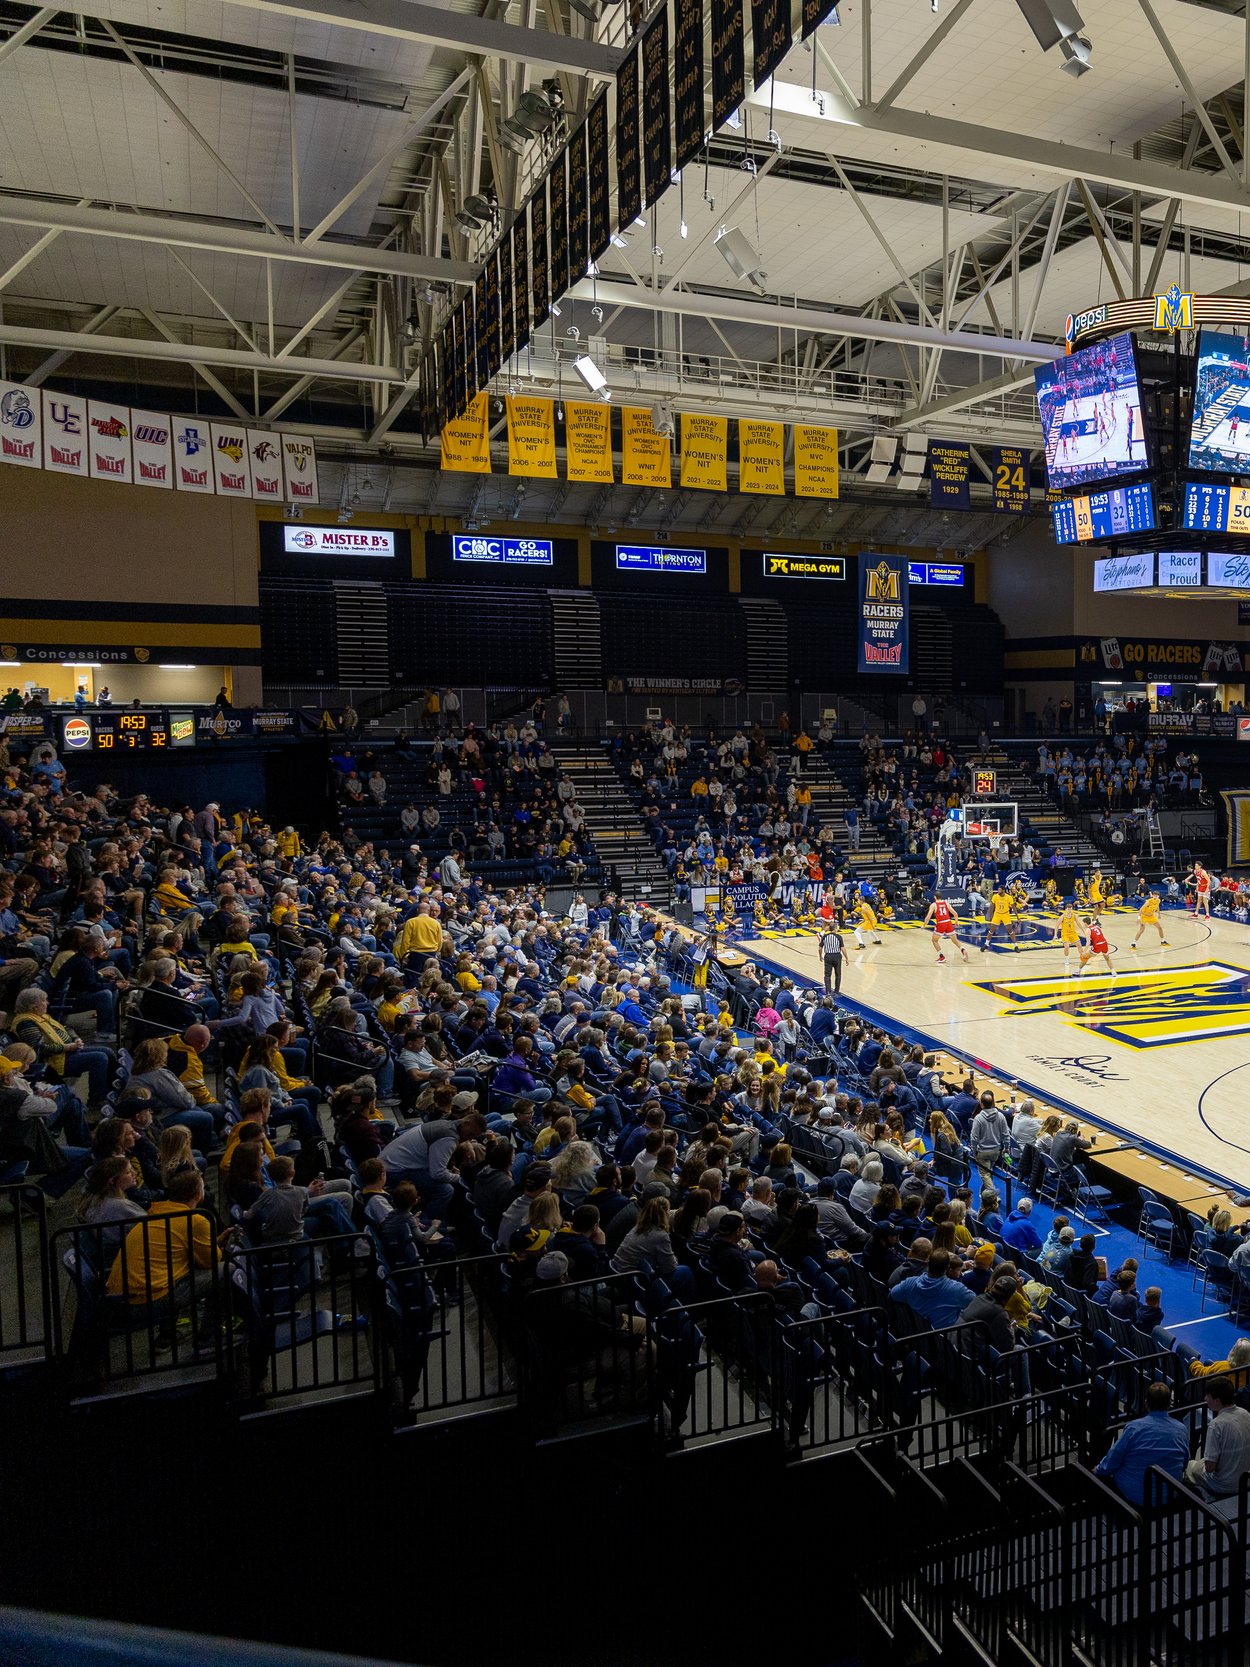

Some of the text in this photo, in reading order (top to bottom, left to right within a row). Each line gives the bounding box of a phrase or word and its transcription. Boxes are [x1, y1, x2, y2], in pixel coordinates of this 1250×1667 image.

[1075, 305, 1106, 334] pepsi
[690, 418, 718, 427] MURRAY
[134, 425, 169, 446] UIC
[684, 433, 724, 444] UNIVERSITY
[803, 430, 830, 438] MURRAY
[218, 436, 244, 448] UNI
[286, 444, 312, 456] VALPO
[798, 444, 834, 452] UNIVERSITY
[931, 448, 969, 458] CATHERINE
[684, 450, 724, 462] WOMEN'S
[1000, 450, 1022, 458] SHEILA
[698, 460, 710, 468] NIT
[798, 464, 835, 474] CHAMPIONS
[932, 464, 968, 474] WICKLIFFE
[687, 476, 721, 486] 2021 2022
[936, 473, 966, 481] PERDEW
[996, 465, 1026, 491] 24
[290, 480, 312, 496] VALLEY
[1090, 494, 1108, 506] 19:53
[1114, 506, 1124, 520] 32
[1078, 513, 1088, 526] 50
[322, 533, 389, 546] MISTER B's
[519, 540, 536, 550] GO
[508, 548, 548, 558] RACERS!
[1170, 554, 1198, 567] Racer
[790, 562, 840, 574] MEGA GYM
[1169, 572, 1198, 586] Proud
[863, 604, 904, 618] RACERS
[867, 620, 899, 629] MURRAY
[872, 630, 895, 638] STATE
[26, 648, 128, 660] Concessions
[864, 642, 902, 662] VALLEY
[1124, 643, 1202, 664] GO RACERS
[1147, 672, 1198, 681] Concessions
[627, 678, 722, 688] THE WINNER'S CIRCLE
[120, 716, 146, 730] 19:53
[252, 718, 276, 726] MURRAY
[1148, 714, 1194, 726] MURRAY
[98, 734, 113, 748] 50
[152, 732, 166, 746] 32
[977, 772, 993, 780] 19:53
[977, 781, 991, 792] 24
[726, 886, 760, 894] CAMPUS
[939, 908, 946, 916] 14
[1094, 928, 1100, 936] 3
[1064, 1072, 1106, 1088] COURT
